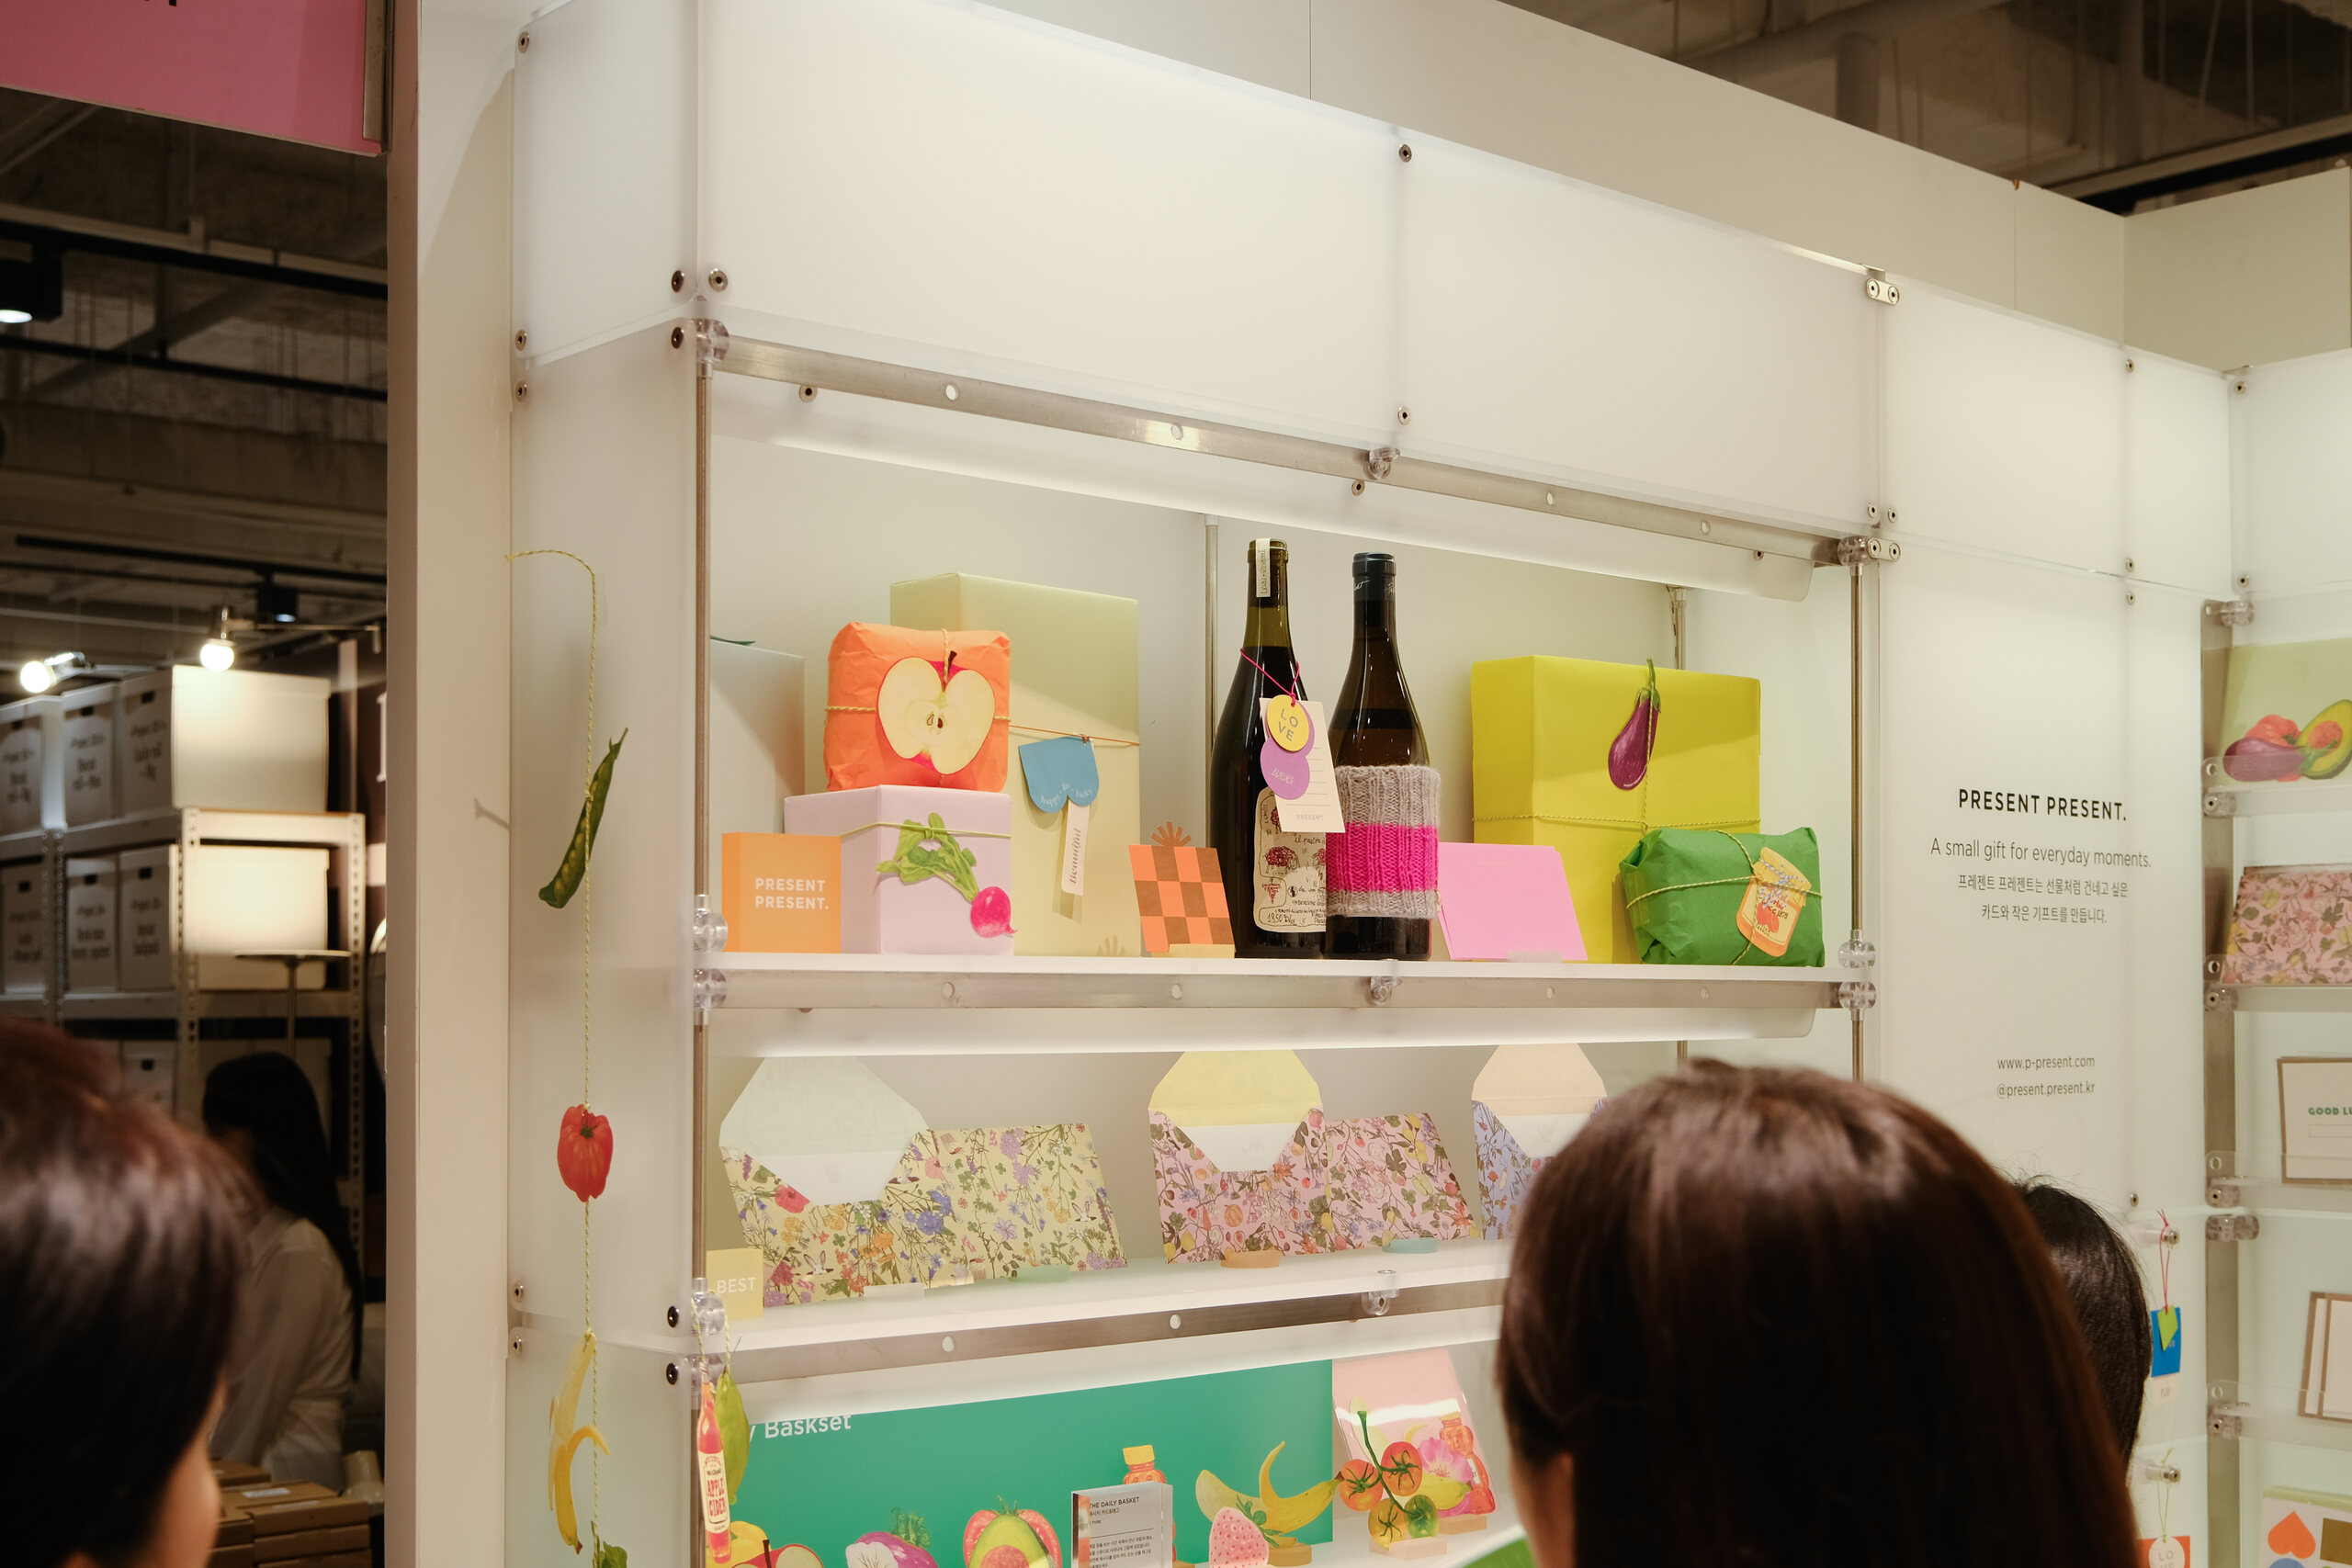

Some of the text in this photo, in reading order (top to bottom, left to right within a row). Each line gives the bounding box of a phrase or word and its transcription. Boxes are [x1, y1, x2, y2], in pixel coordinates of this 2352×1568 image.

[1959, 788, 2127, 821] PRESENT PRESENT.
[1930, 837, 2152, 868] A small gift for everyday moments.
[755, 877, 826, 892] PRESENT
[1958, 874, 2129, 897] 프레젠트 프레젠트는 선물처럼 건네고 싶은
[755, 896, 830, 910] PRESENT.
[1982, 904, 2108, 924] 카드와 작은 기프트를 만듭니다.
[1997, 1055, 2095, 1072] www.p-present.com
[1997, 1080, 2095, 1099] @present.present.kr
[2308, 1106, 2340, 1116] GOOD
[717, 1276, 757, 1294] BEST
[764, 1414, 852, 1439] Baskset
[707, 1476, 725, 1497] APPLE
[708, 1497, 727, 1517] CIDER
[1101, 1499, 1118, 1508] DAILY
[1118, 1496, 1140, 1506] BASKET
